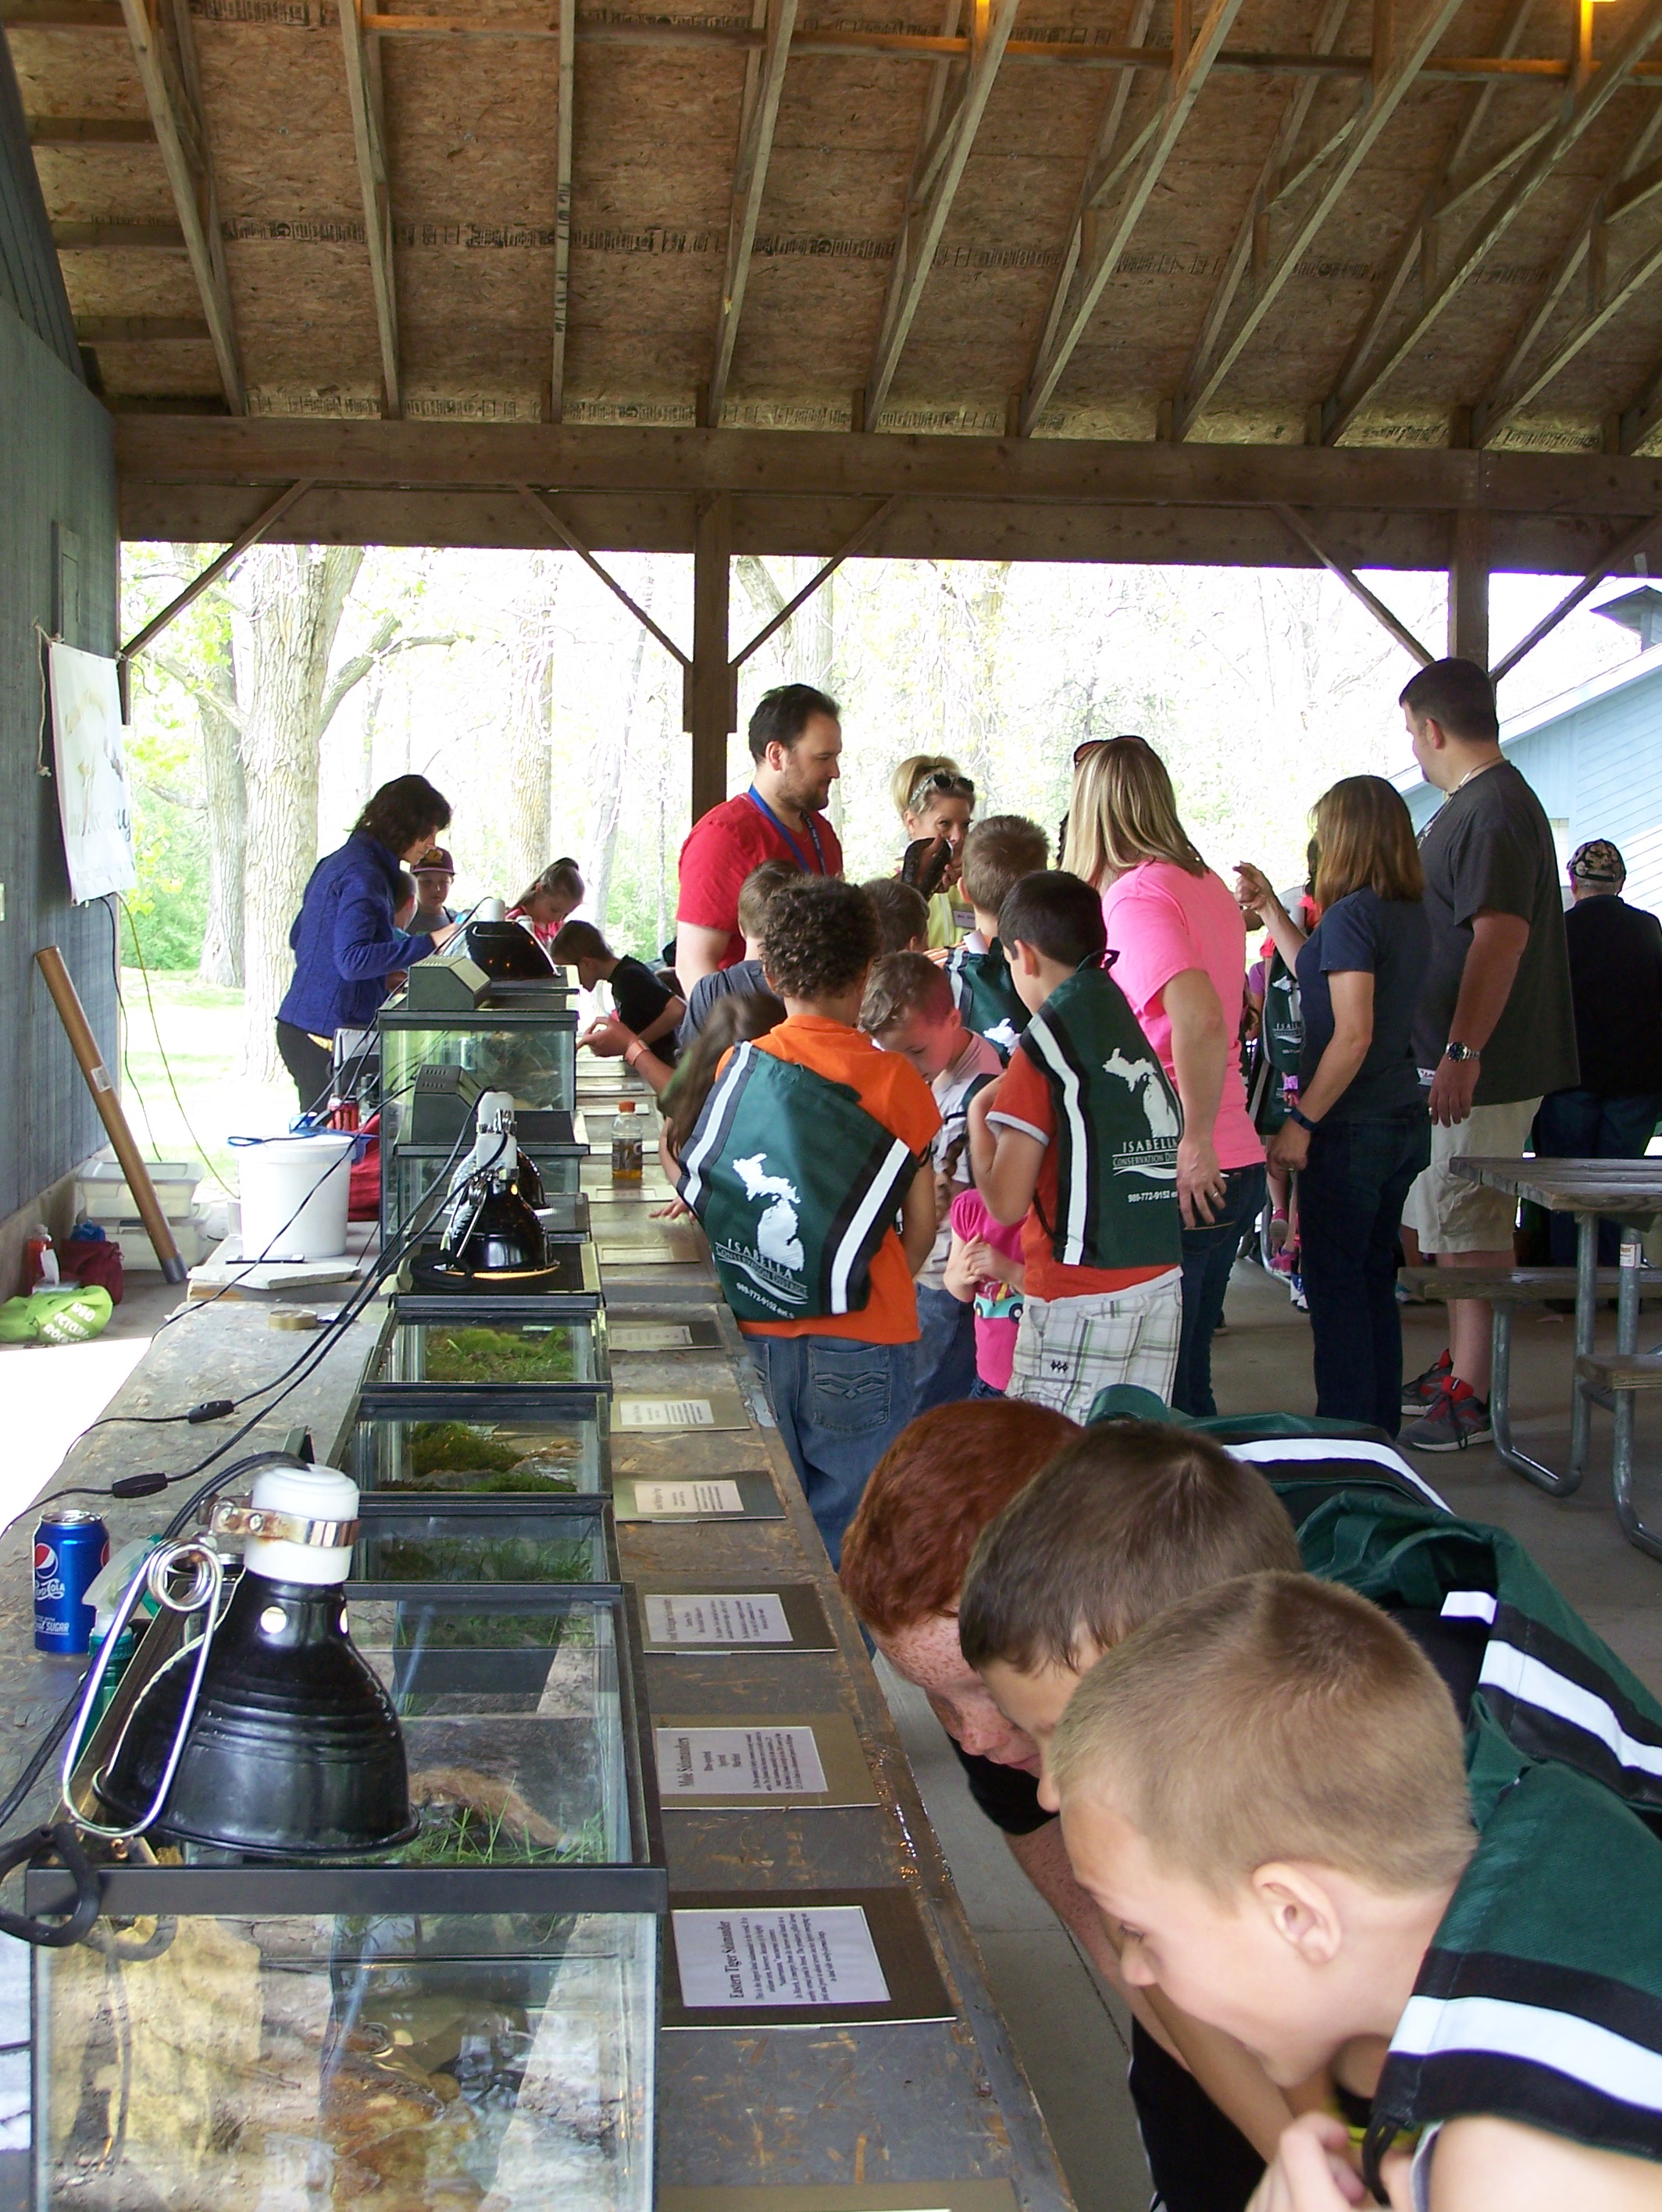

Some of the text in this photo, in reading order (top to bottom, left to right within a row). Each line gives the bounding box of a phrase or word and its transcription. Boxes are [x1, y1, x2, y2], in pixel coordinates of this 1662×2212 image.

[727, 1238, 794, 1280] ISABELLA
[46, 1622, 70, 1632] SUGAR
[717, 1921, 744, 1999] Eastern Tiger Salamander
